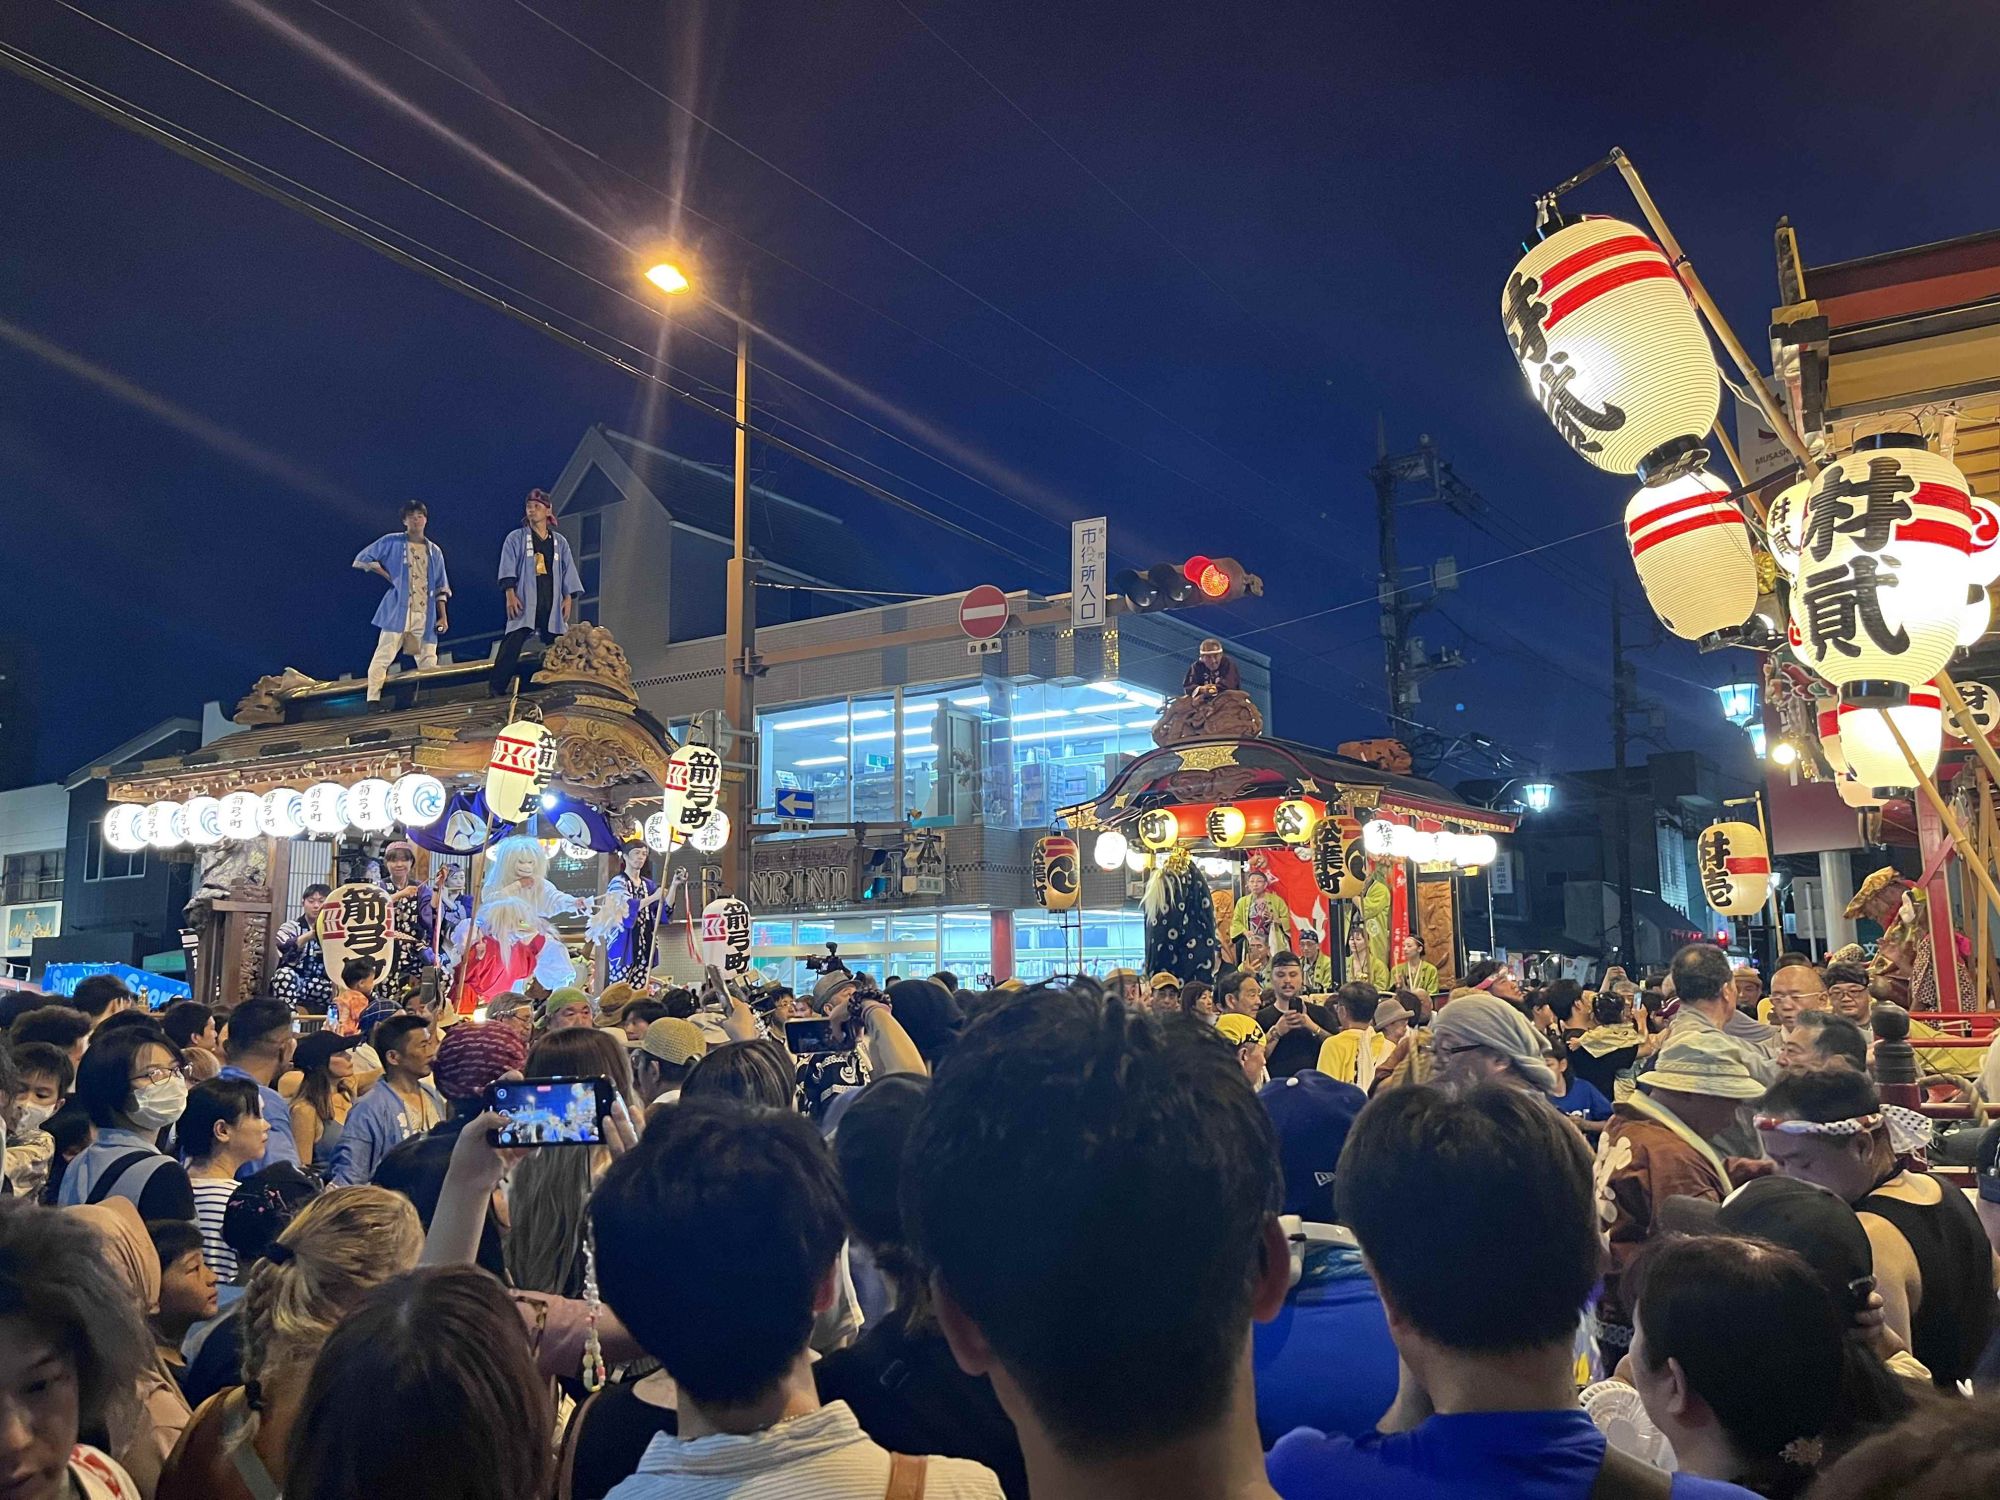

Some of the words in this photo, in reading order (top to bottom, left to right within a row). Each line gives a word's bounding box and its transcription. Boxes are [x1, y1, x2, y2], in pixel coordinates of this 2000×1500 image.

[1755, 448, 1791, 465] MUSASH
[1080, 527, 1097, 620] 市役所入口
[679, 751, 719, 829] 箭弓町
[701, 865, 849, 907] BNRIND
[723, 901, 751, 975] 箭弓町
